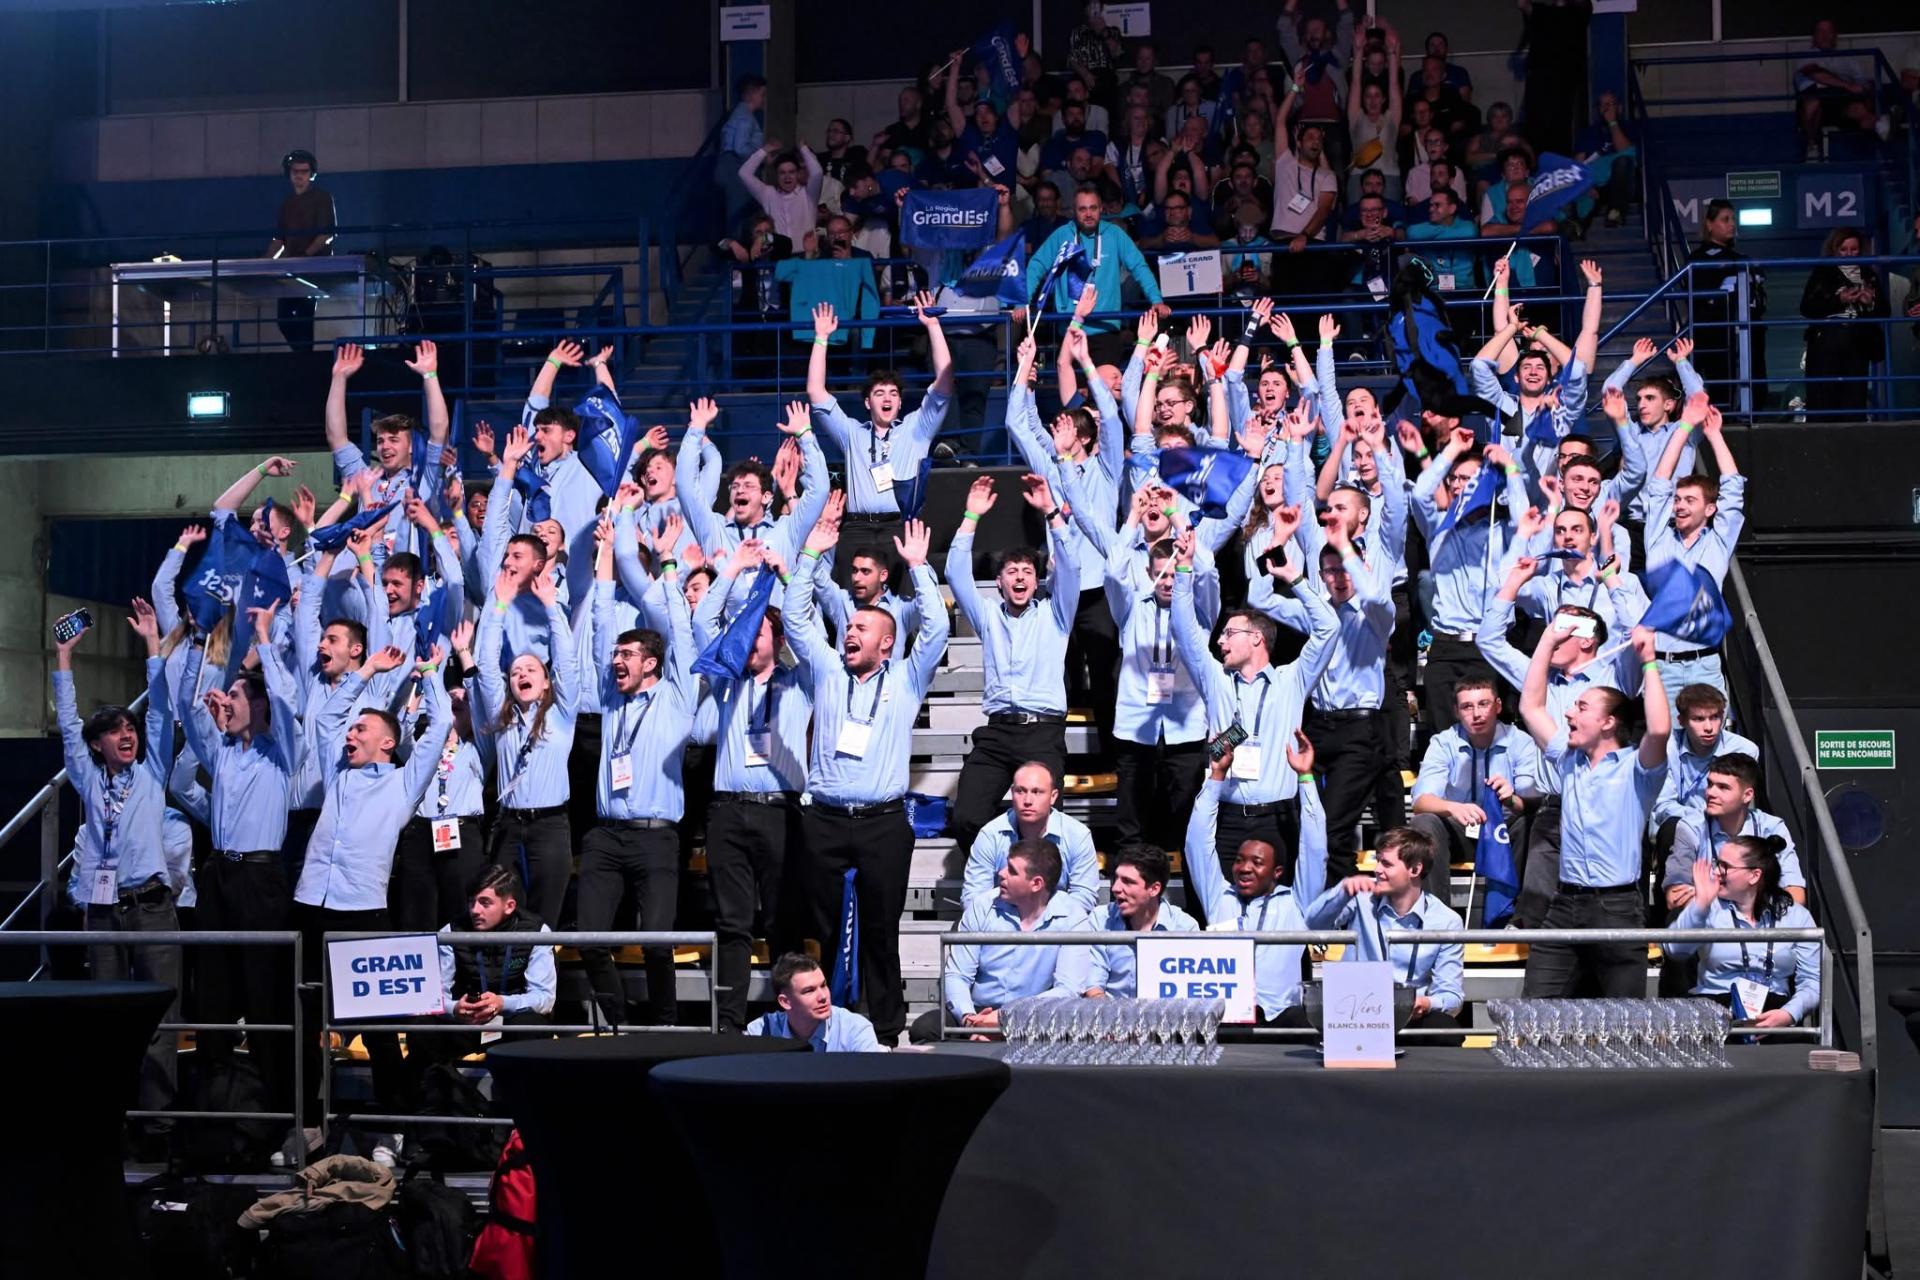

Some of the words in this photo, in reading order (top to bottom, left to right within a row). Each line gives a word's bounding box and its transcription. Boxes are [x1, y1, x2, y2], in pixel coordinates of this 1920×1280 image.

[1805, 191, 1857, 218] M2
[912, 210, 964, 225] Grand
[965, 210, 990, 225] Est
[1820, 740, 1845, 749] SORTIE
[1847, 740, 1857, 749] DE
[1858, 740, 1891, 749] SECOURS
[1820, 750, 1830, 758] NE
[1832, 750, 1846, 758] PAS
[1847, 750, 1892, 758] ENCOMBRER
[351, 954, 423, 973] GRAN
[1159, 957, 1236, 975] GRAN
[352, 981, 370, 997] D
[379, 977, 426, 996] EST
[1159, 982, 1178, 999] D
[1187, 982, 1238, 999] EST
